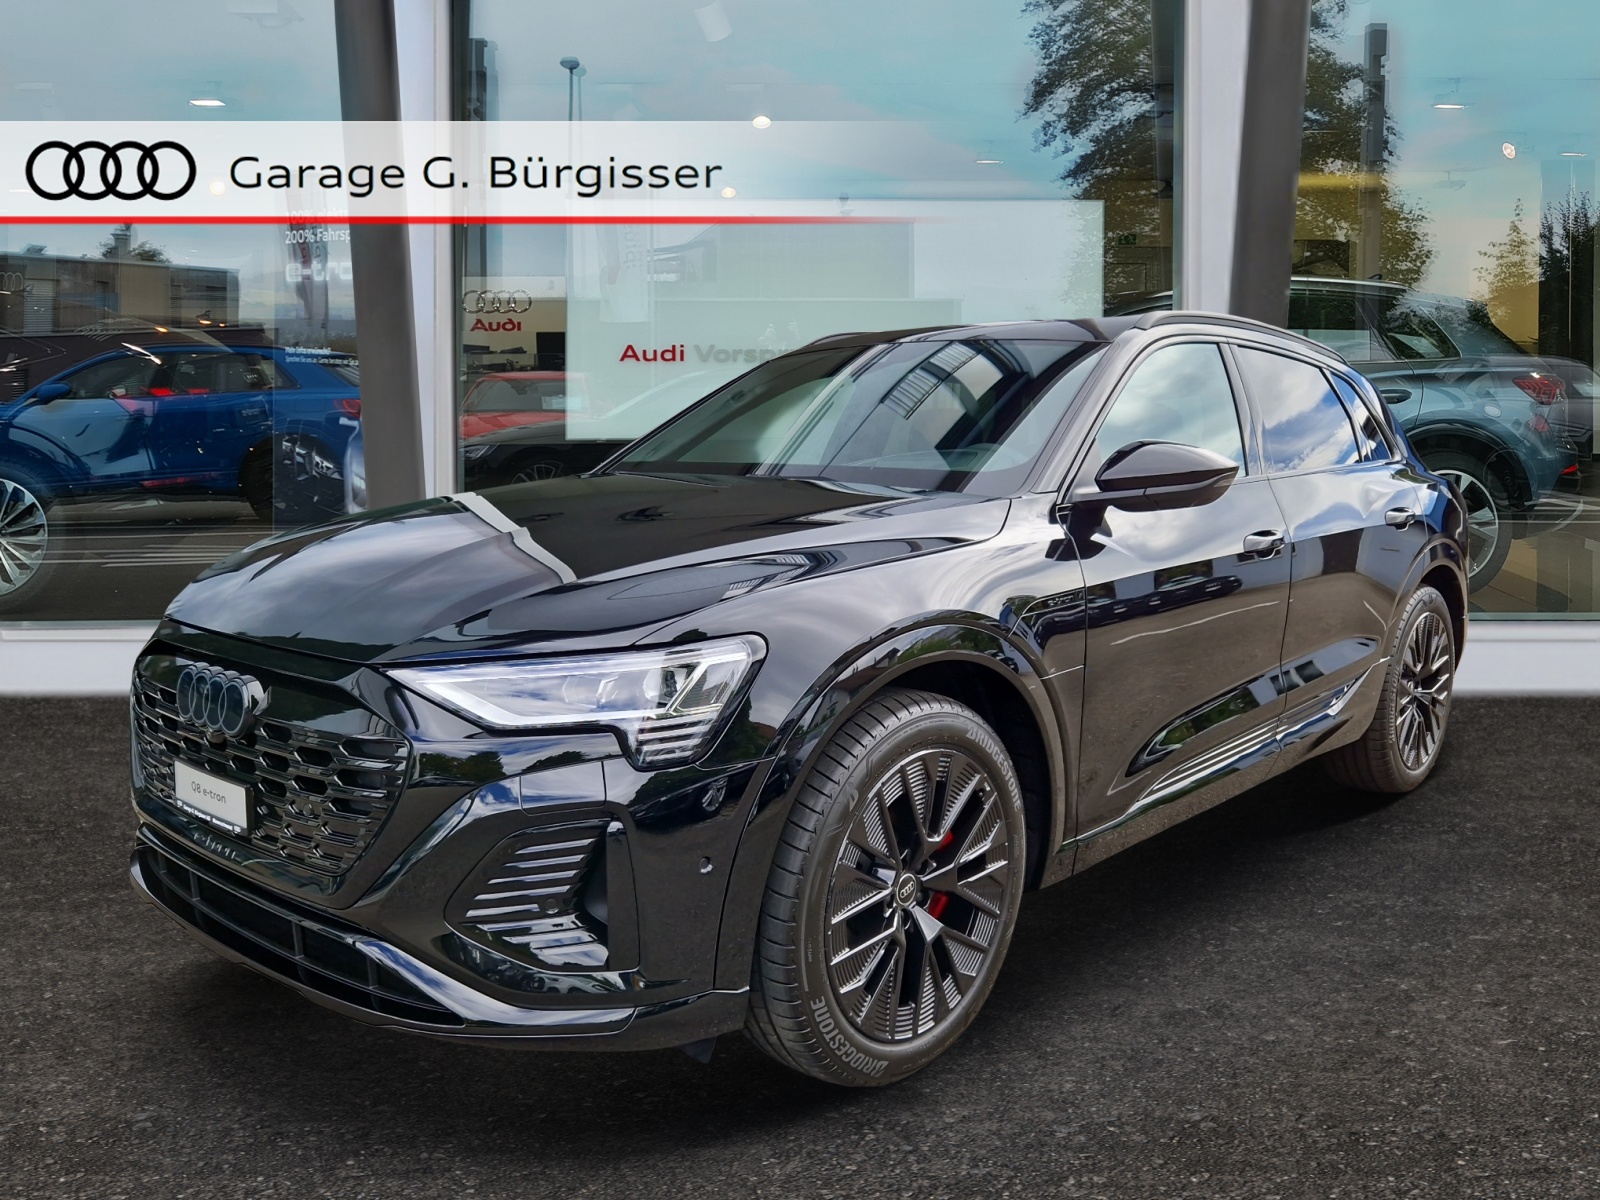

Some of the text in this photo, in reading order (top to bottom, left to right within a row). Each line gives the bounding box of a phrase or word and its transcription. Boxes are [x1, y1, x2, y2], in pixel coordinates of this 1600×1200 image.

[285, 229, 315, 244] 200%
[469, 318, 522, 332] Audi
[619, 343, 797, 363] Audi Vorsp
[965, 725, 1022, 812] BRIDGESTONE
[191, 781, 227, 804] Q8 e-tron
[810, 995, 890, 1078] BRIDGESTONE
